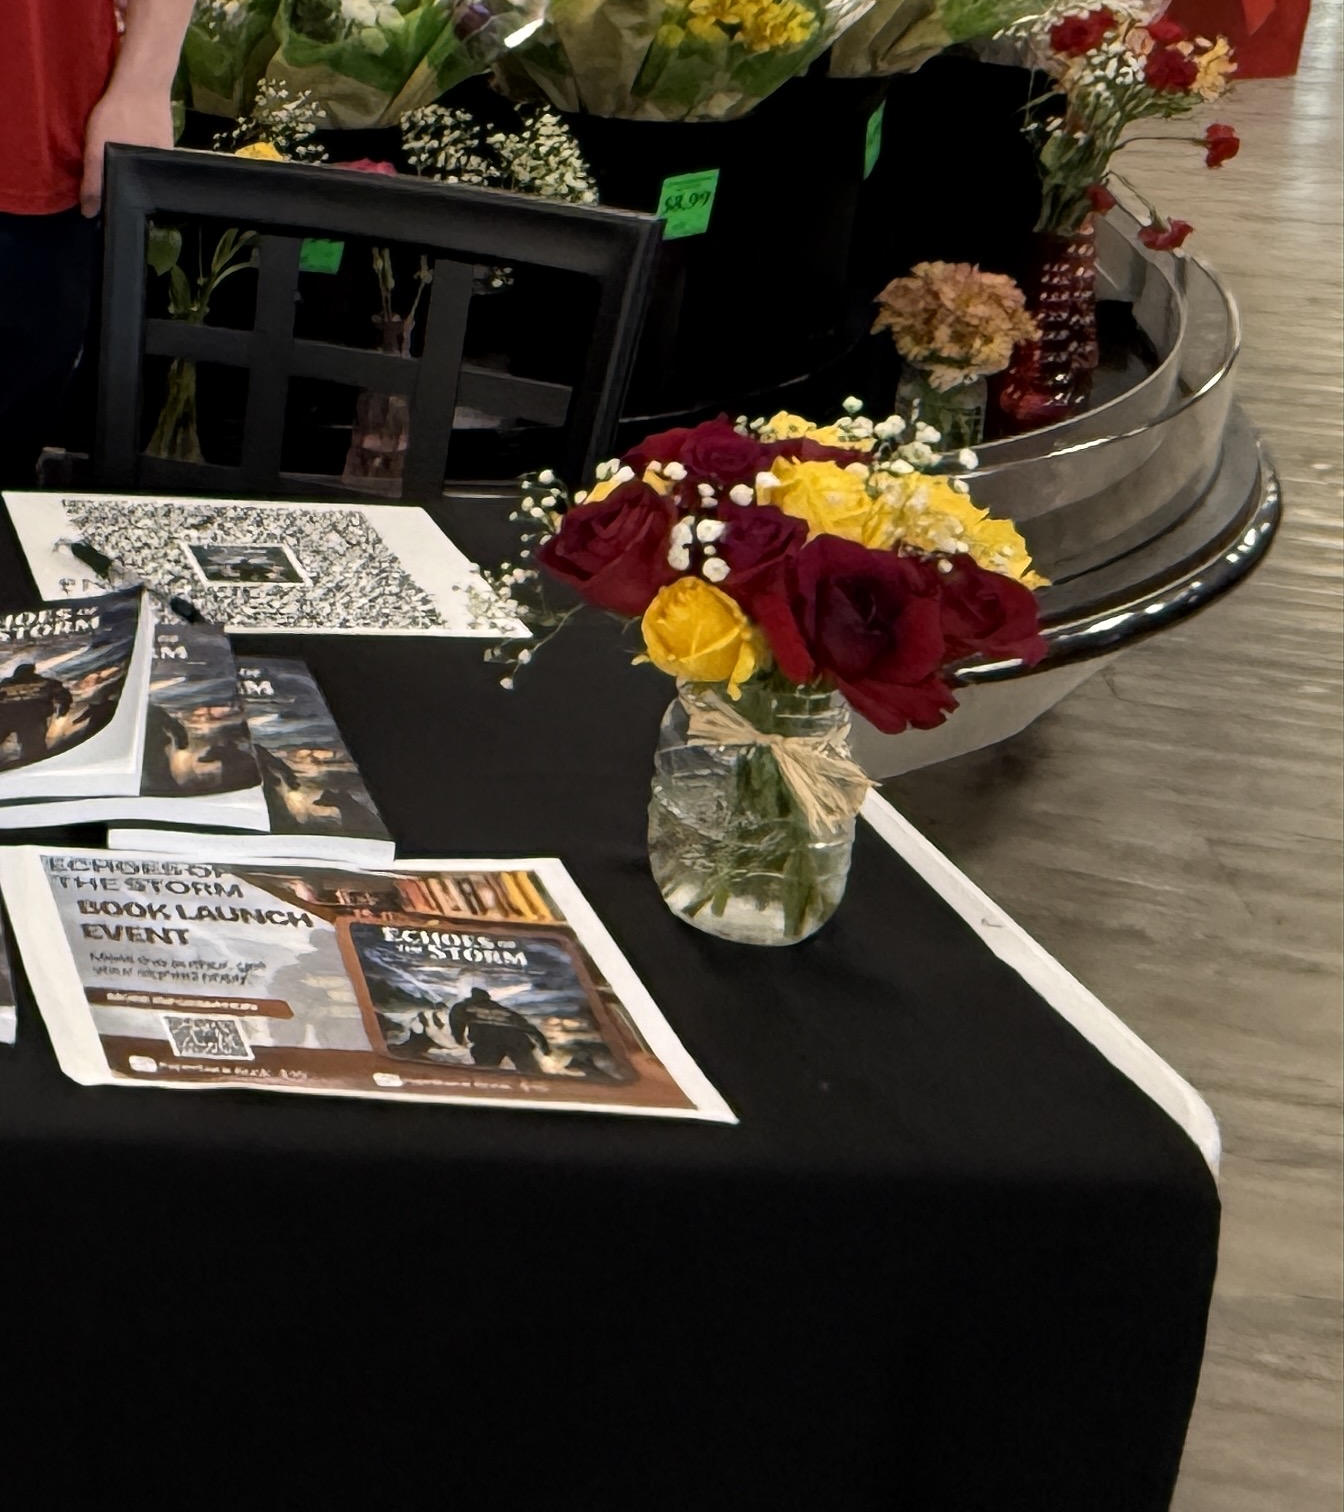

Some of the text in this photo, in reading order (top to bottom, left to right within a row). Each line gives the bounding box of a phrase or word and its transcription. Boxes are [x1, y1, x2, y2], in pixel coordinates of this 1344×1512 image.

[52, 875, 244, 899] THE STORM
[77, 899, 314, 929] BOOK LAUNCH
[81, 923, 190, 946] EVENT
[382, 926, 494, 950] ECHOES
[427, 944, 529, 967] STORM
